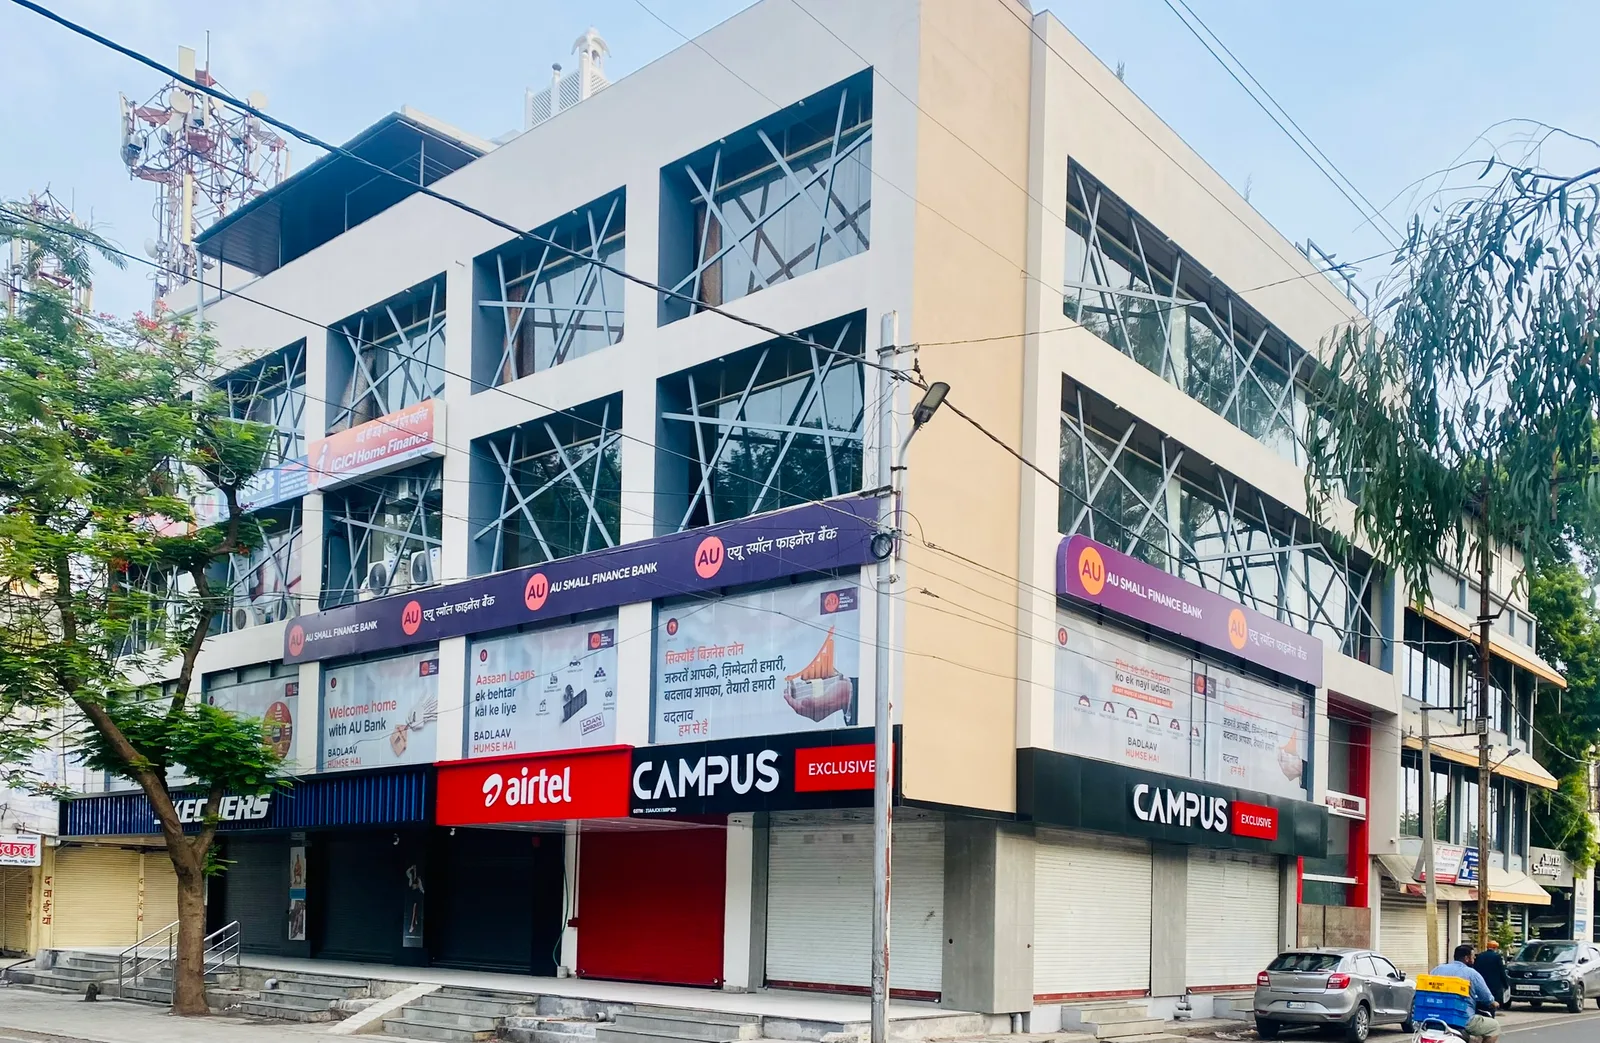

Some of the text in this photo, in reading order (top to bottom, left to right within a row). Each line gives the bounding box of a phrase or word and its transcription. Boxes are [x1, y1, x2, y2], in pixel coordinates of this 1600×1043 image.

[331, 453, 355, 472] ICICI
[357, 446, 385, 462] Home
[387, 432, 428, 452] Finance
[698, 547, 719, 566] AU
[550, 562, 657, 594] AU SMALL FINANCE BANK
[1082, 563, 1100, 580] AU
[527, 582, 545, 600] AU
[1106, 572, 1202, 620] AU SMALL FINANCE BANK
[404, 610, 419, 625] AU
[305, 620, 378, 643] AU SMALL FINANCE BANK
[1230, 620, 1245, 638] AU
[290, 633, 302, 646] AU
[728, 642, 744, 656] लोन
[690, 664, 719, 680] आपकी,
[760, 655, 786, 671] हमारी,
[476, 668, 536, 686] Aasaan Loans
[1116, 671, 1170, 696] ko ek nayi udaan
[475, 687, 516, 702] ek behtar
[664, 675, 776, 702] बदलाव आपका, तैयारी हमारी
[329, 698, 397, 720] Welcome home
[474, 702, 517, 719] kal ke liye
[664, 710, 694, 724] बदलाव
[328, 718, 386, 738] with AU Bank
[582, 716, 602, 727] LOAN
[678, 719, 708, 736] हम से है
[474, 728, 512, 741] BADLAAV
[328, 746, 358, 758] BADLAAV
[473, 741, 516, 753] HUMSE HAI
[1128, 737, 1158, 750] BADLAAV
[328, 758, 362, 768] HUMSE HAI
[1126, 749, 1148, 760] HUMSE
[633, 749, 780, 800] CAMPUS
[808, 760, 876, 776] EXCLUSIVE
[506, 766, 572, 806] airtel
[1133, 784, 1228, 832] CAMPUS
[1241, 814, 1272, 828] EXCLUSIVE
